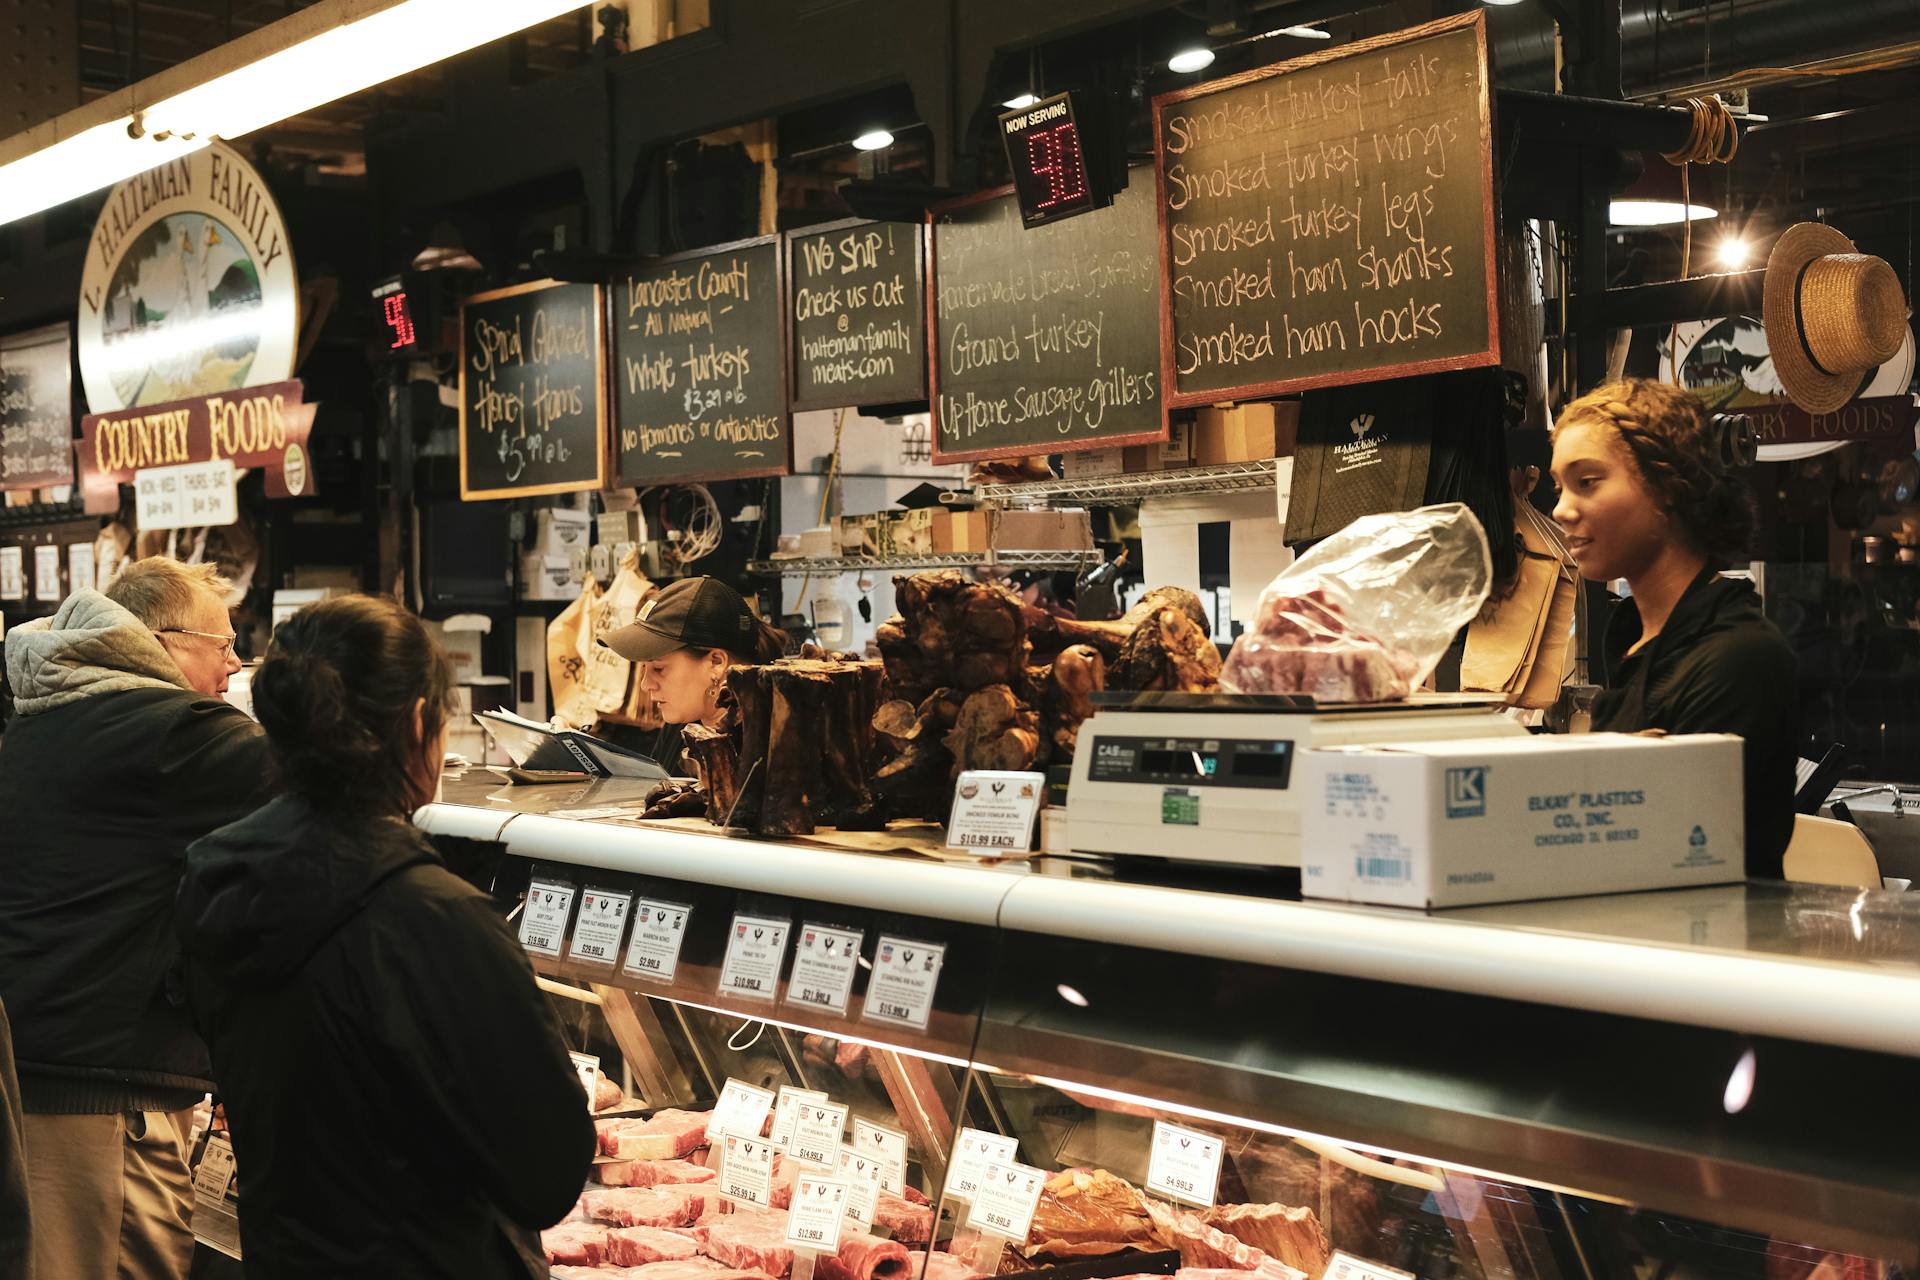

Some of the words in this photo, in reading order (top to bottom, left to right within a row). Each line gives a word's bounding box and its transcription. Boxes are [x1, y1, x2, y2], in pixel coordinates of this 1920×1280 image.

[1006, 116, 1028, 133] NOW
[1028, 102, 1067, 126] SERVING
[1167, 91, 1275, 154] Smoked
[1277, 71, 1365, 132] turkey
[1374, 54, 1440, 108] tails
[1029, 123, 1083, 207] 90
[1167, 151, 1271, 210] Smoked
[1278, 136, 1361, 188] turkey
[1373, 117, 1458, 178] wings
[210, 153, 283, 270] FAMILY
[1172, 206, 1275, 266] Smoked
[1280, 195, 1362, 250] turkey
[1382, 181, 1434, 243] legs
[803, 236, 835, 277] We
[1173, 258, 1276, 308] Smoked
[1288, 250, 1347, 298] ham
[628, 270, 694, 317] Lancaster
[796, 285, 842, 322] Check
[847, 285, 867, 308] us
[645, 312, 663, 336] All
[669, 303, 713, 335] Natural
[837, 314, 849, 332] @
[950, 321, 1020, 376] Ground
[1025, 311, 1104, 367] turkey
[1178, 320, 1273, 375] Smoked
[1283, 314, 1347, 359] ham
[1355, 297, 1442, 347] hocks
[472, 315, 524, 382] Spiral
[626, 351, 676, 394] Whole
[681, 343, 750, 390] turkeys
[812, 356, 894, 384] meats.com
[533, 374, 583, 432] Hams
[1085, 366, 1154, 430] grillers
[95, 409, 190, 474] COUNTRY
[207, 395, 286, 462] FOODS
[640, 421, 695, 454] Hormones
[700, 423, 710, 437] or
[1098, 744, 1119, 757] CAS
[1579, 790, 1645, 808] PLASTICS
[960, 833, 989, 845] $10.99
[991, 835, 1015, 847] EACH
[1166, 1175, 1193, 1192] $4.99LB
[986, 1212, 1011, 1228] $6.99LB
